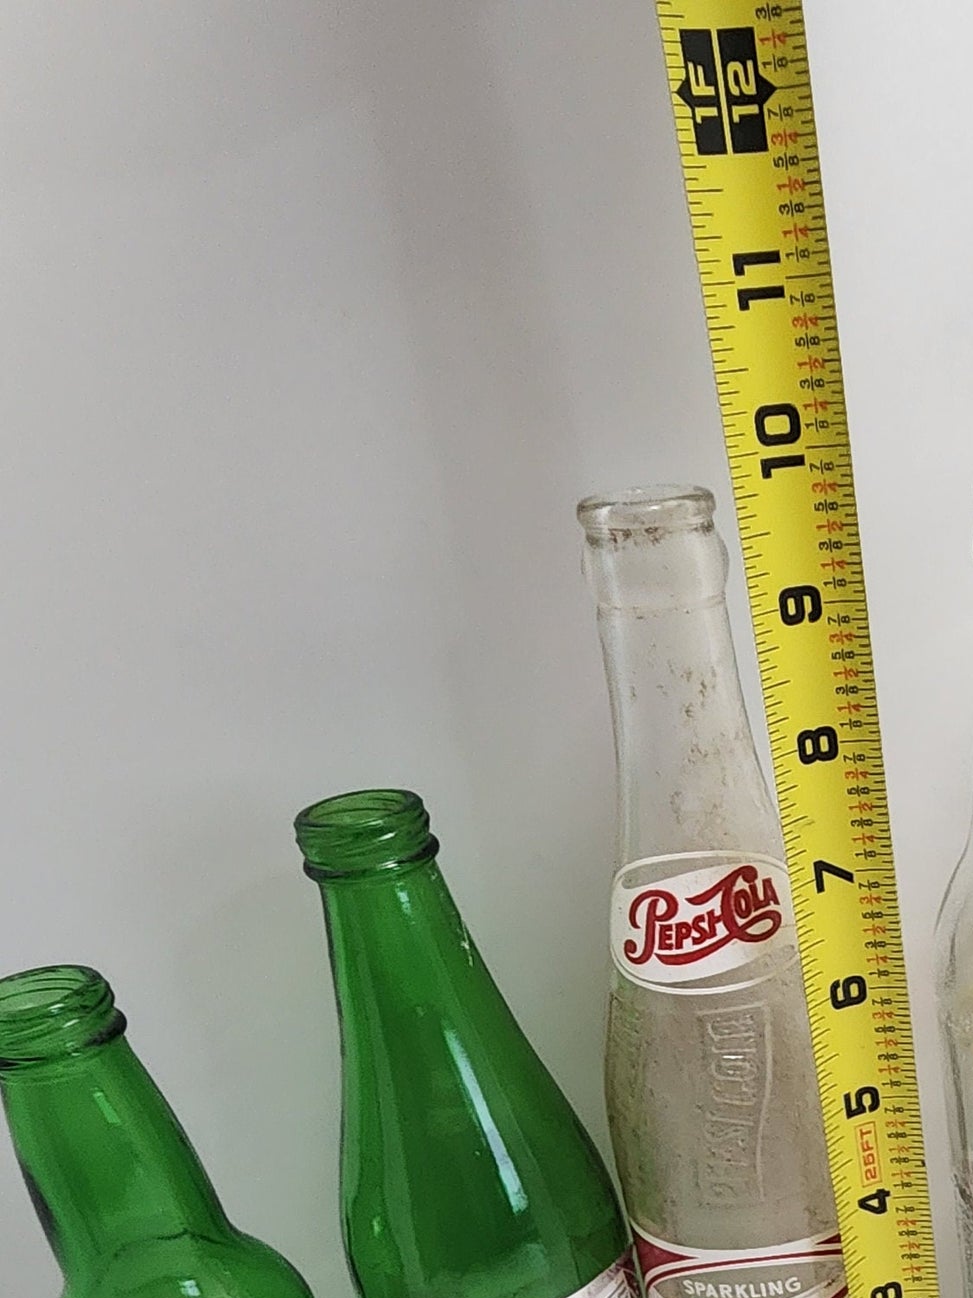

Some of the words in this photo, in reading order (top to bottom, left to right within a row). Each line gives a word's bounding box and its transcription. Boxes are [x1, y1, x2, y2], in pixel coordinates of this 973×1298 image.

[688, 61, 719, 124] 1F
[727, 60, 760, 123] 12
[732, 249, 785, 311] 11
[754, 403, 806, 480] 10
[778, 584, 822, 627] 9
[797, 726, 839, 765] 8
[813, 860, 854, 894] 7
[830, 975, 868, 1011] 6
[843, 1086, 880, 1120] 5
[857, 1188, 891, 1216] 4
